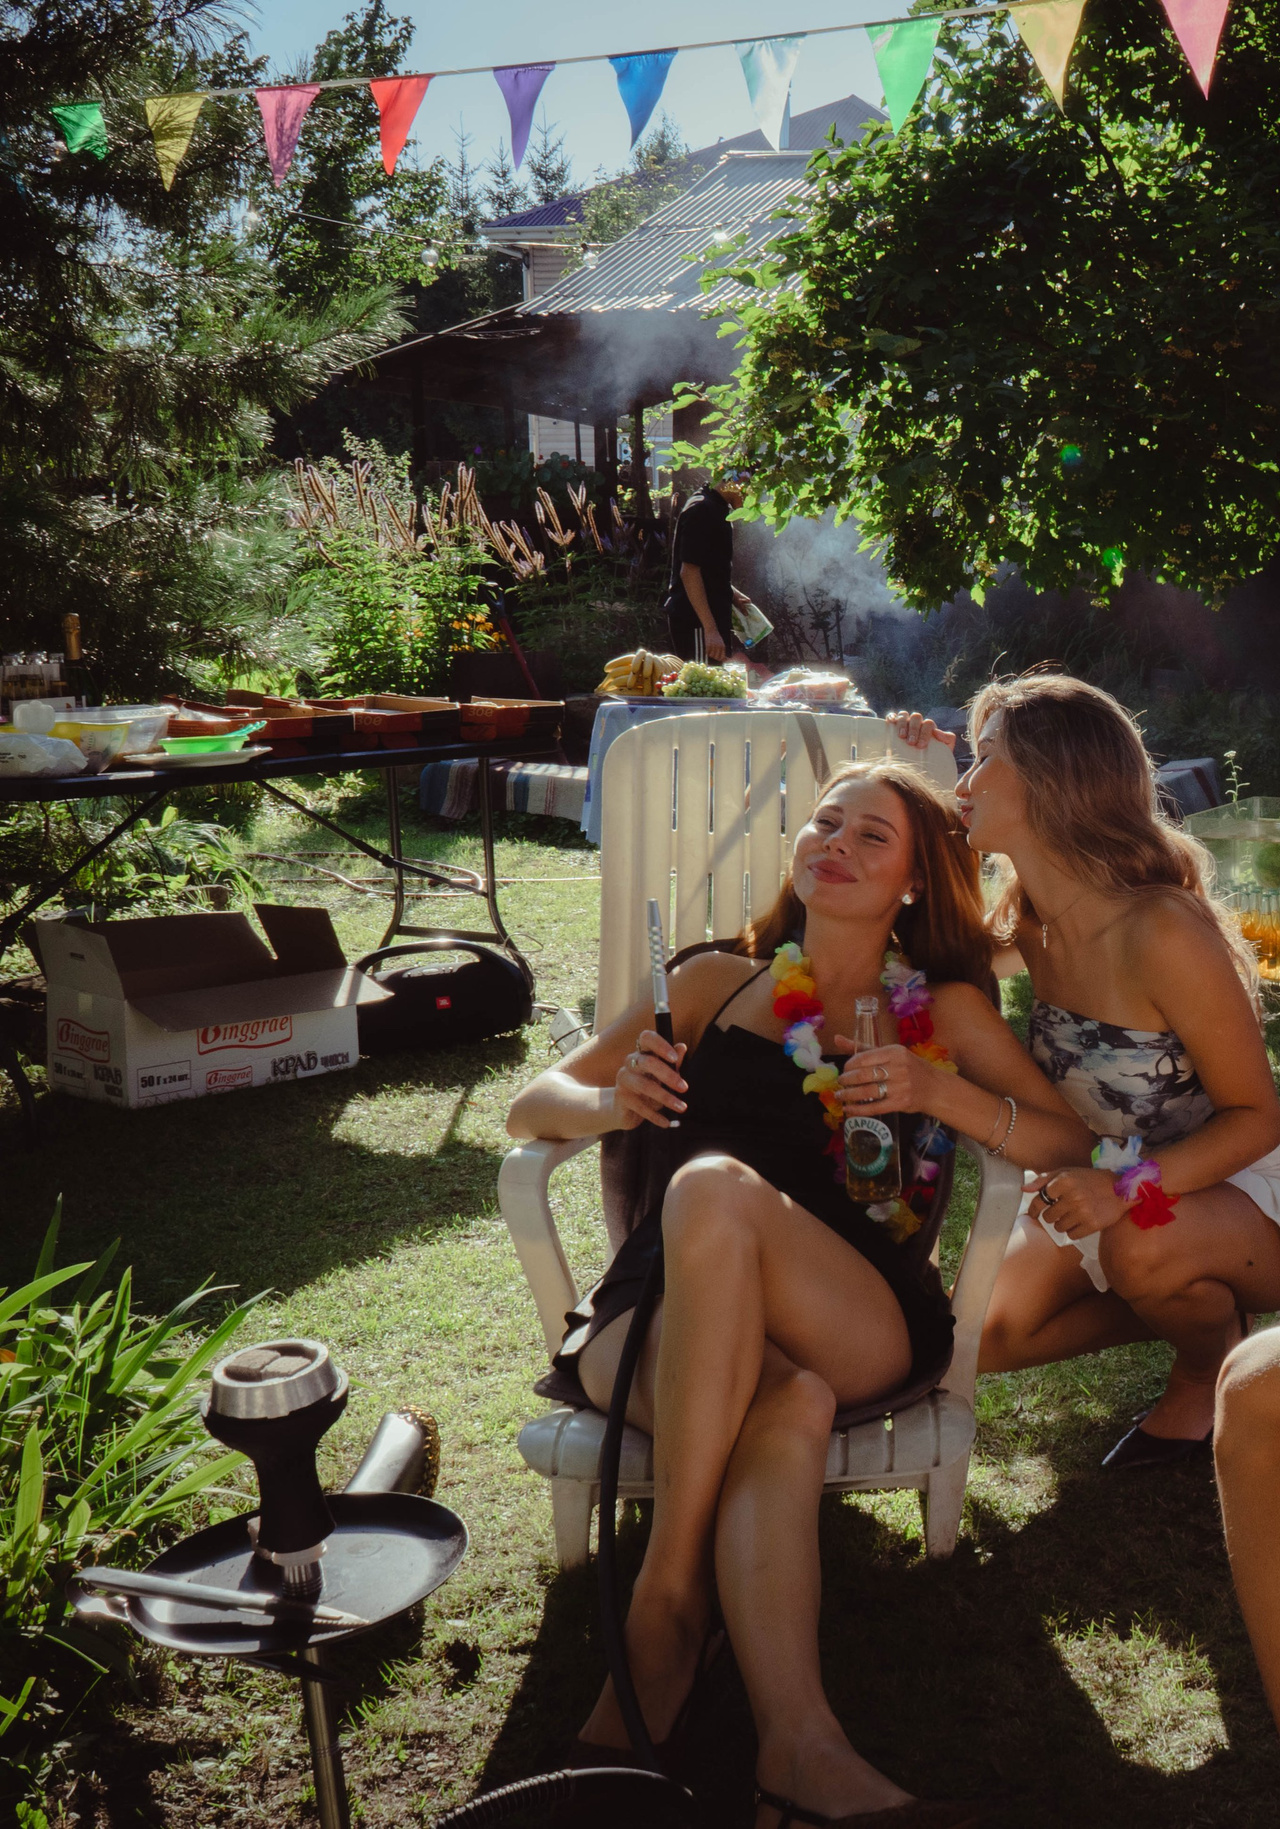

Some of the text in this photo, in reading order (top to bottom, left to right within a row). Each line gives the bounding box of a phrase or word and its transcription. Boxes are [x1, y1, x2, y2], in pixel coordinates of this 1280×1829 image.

[60, 1023, 108, 1052] Binggrae
[271, 1051, 318, 1076] КРАБ
[140, 1075, 155, 1088] 50
[168, 1075, 177, 1083] 24
[207, 1070, 251, 1085] Binggrae
[848, 1119, 889, 1140] CAPULCO
